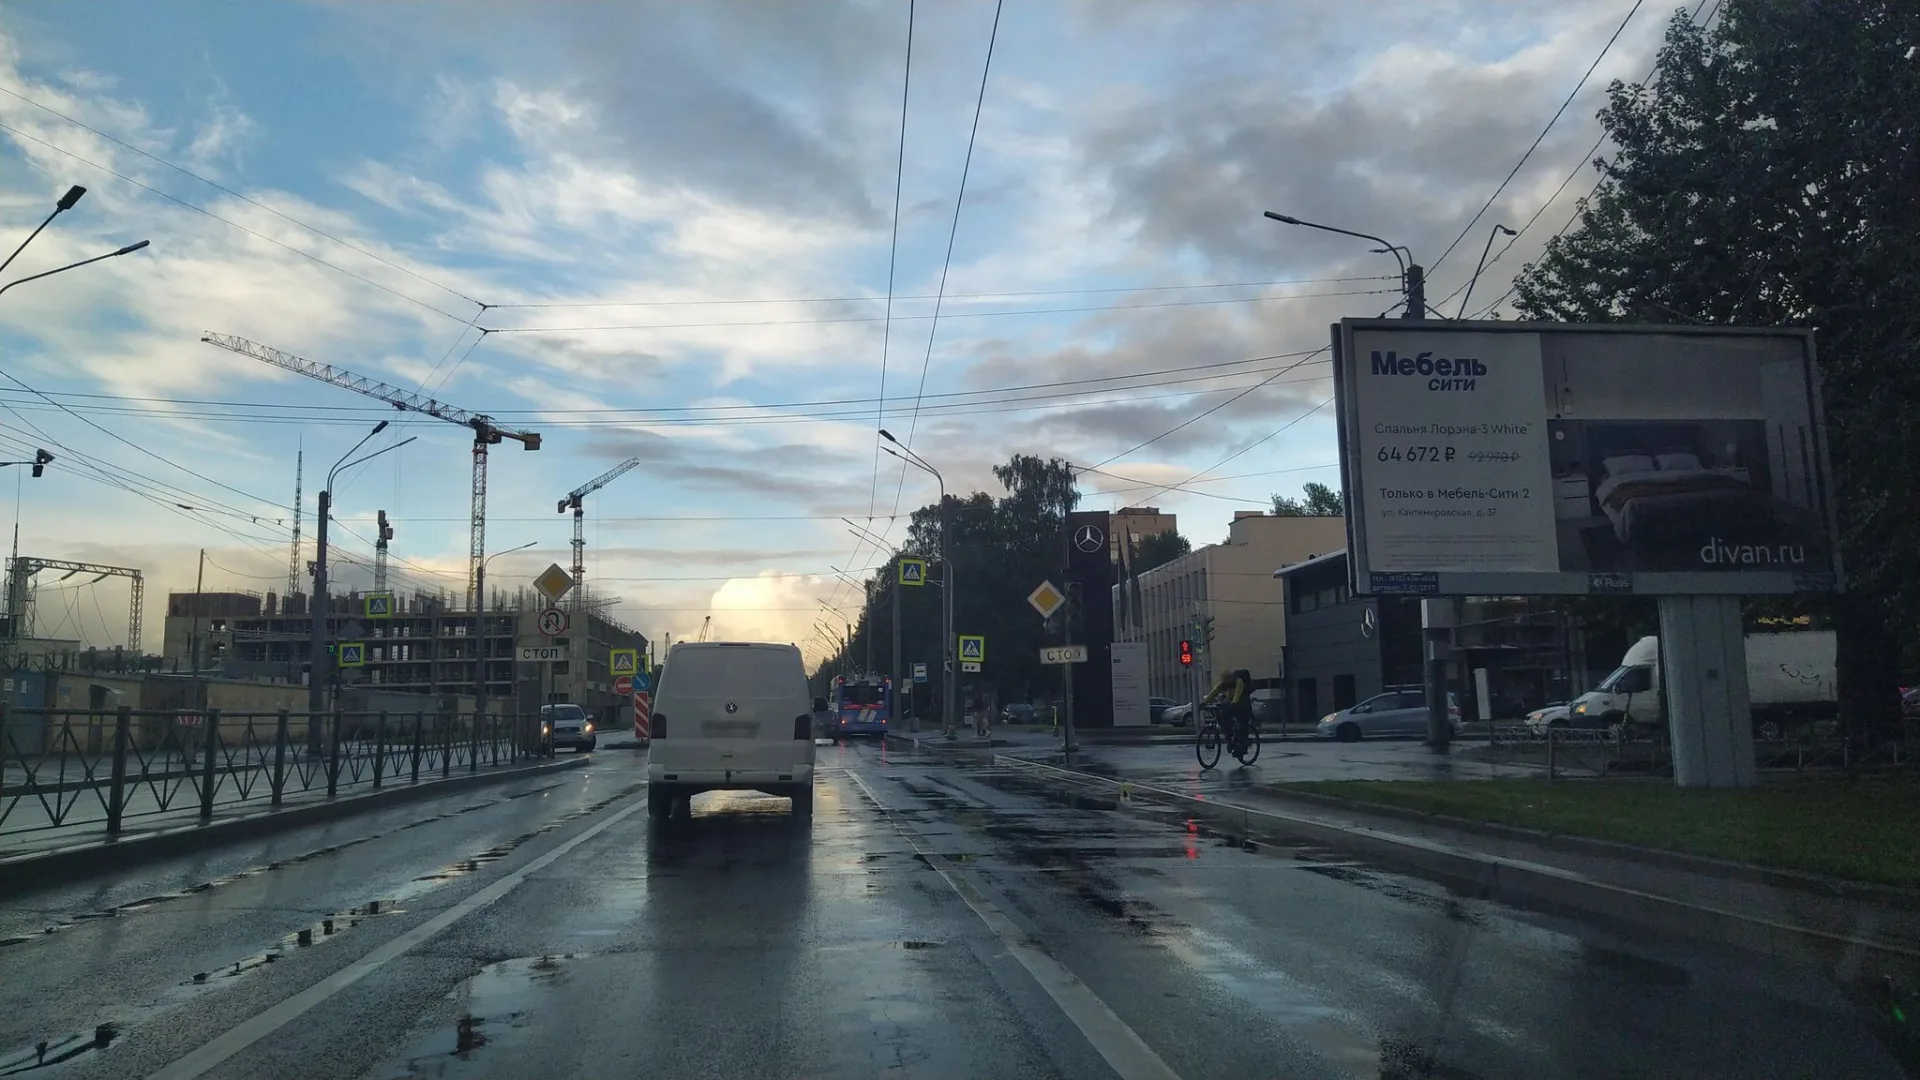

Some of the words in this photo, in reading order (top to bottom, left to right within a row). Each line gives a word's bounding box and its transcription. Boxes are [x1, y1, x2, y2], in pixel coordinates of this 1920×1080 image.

[1371, 350, 1487, 376] Мебель
[1428, 378, 1476, 391] сити
[1374, 423, 1427, 435] Спальня
[1430, 423, 1489, 437] Лорэна-3
[1377, 446, 1402, 462] 64
[1406, 446, 1440, 462] 672
[1380, 488, 1424, 499] Только
[1427, 490, 1434, 499] в
[1438, 487, 1519, 499] Мебель-Сити
[1522, 488, 1530, 499] 2
[1381, 508, 1395, 518] ул.
[1487, 508, 1497, 516] 37
[1700, 536, 1805, 563] divan.ru
[523, 648, 558, 659] СТОП
